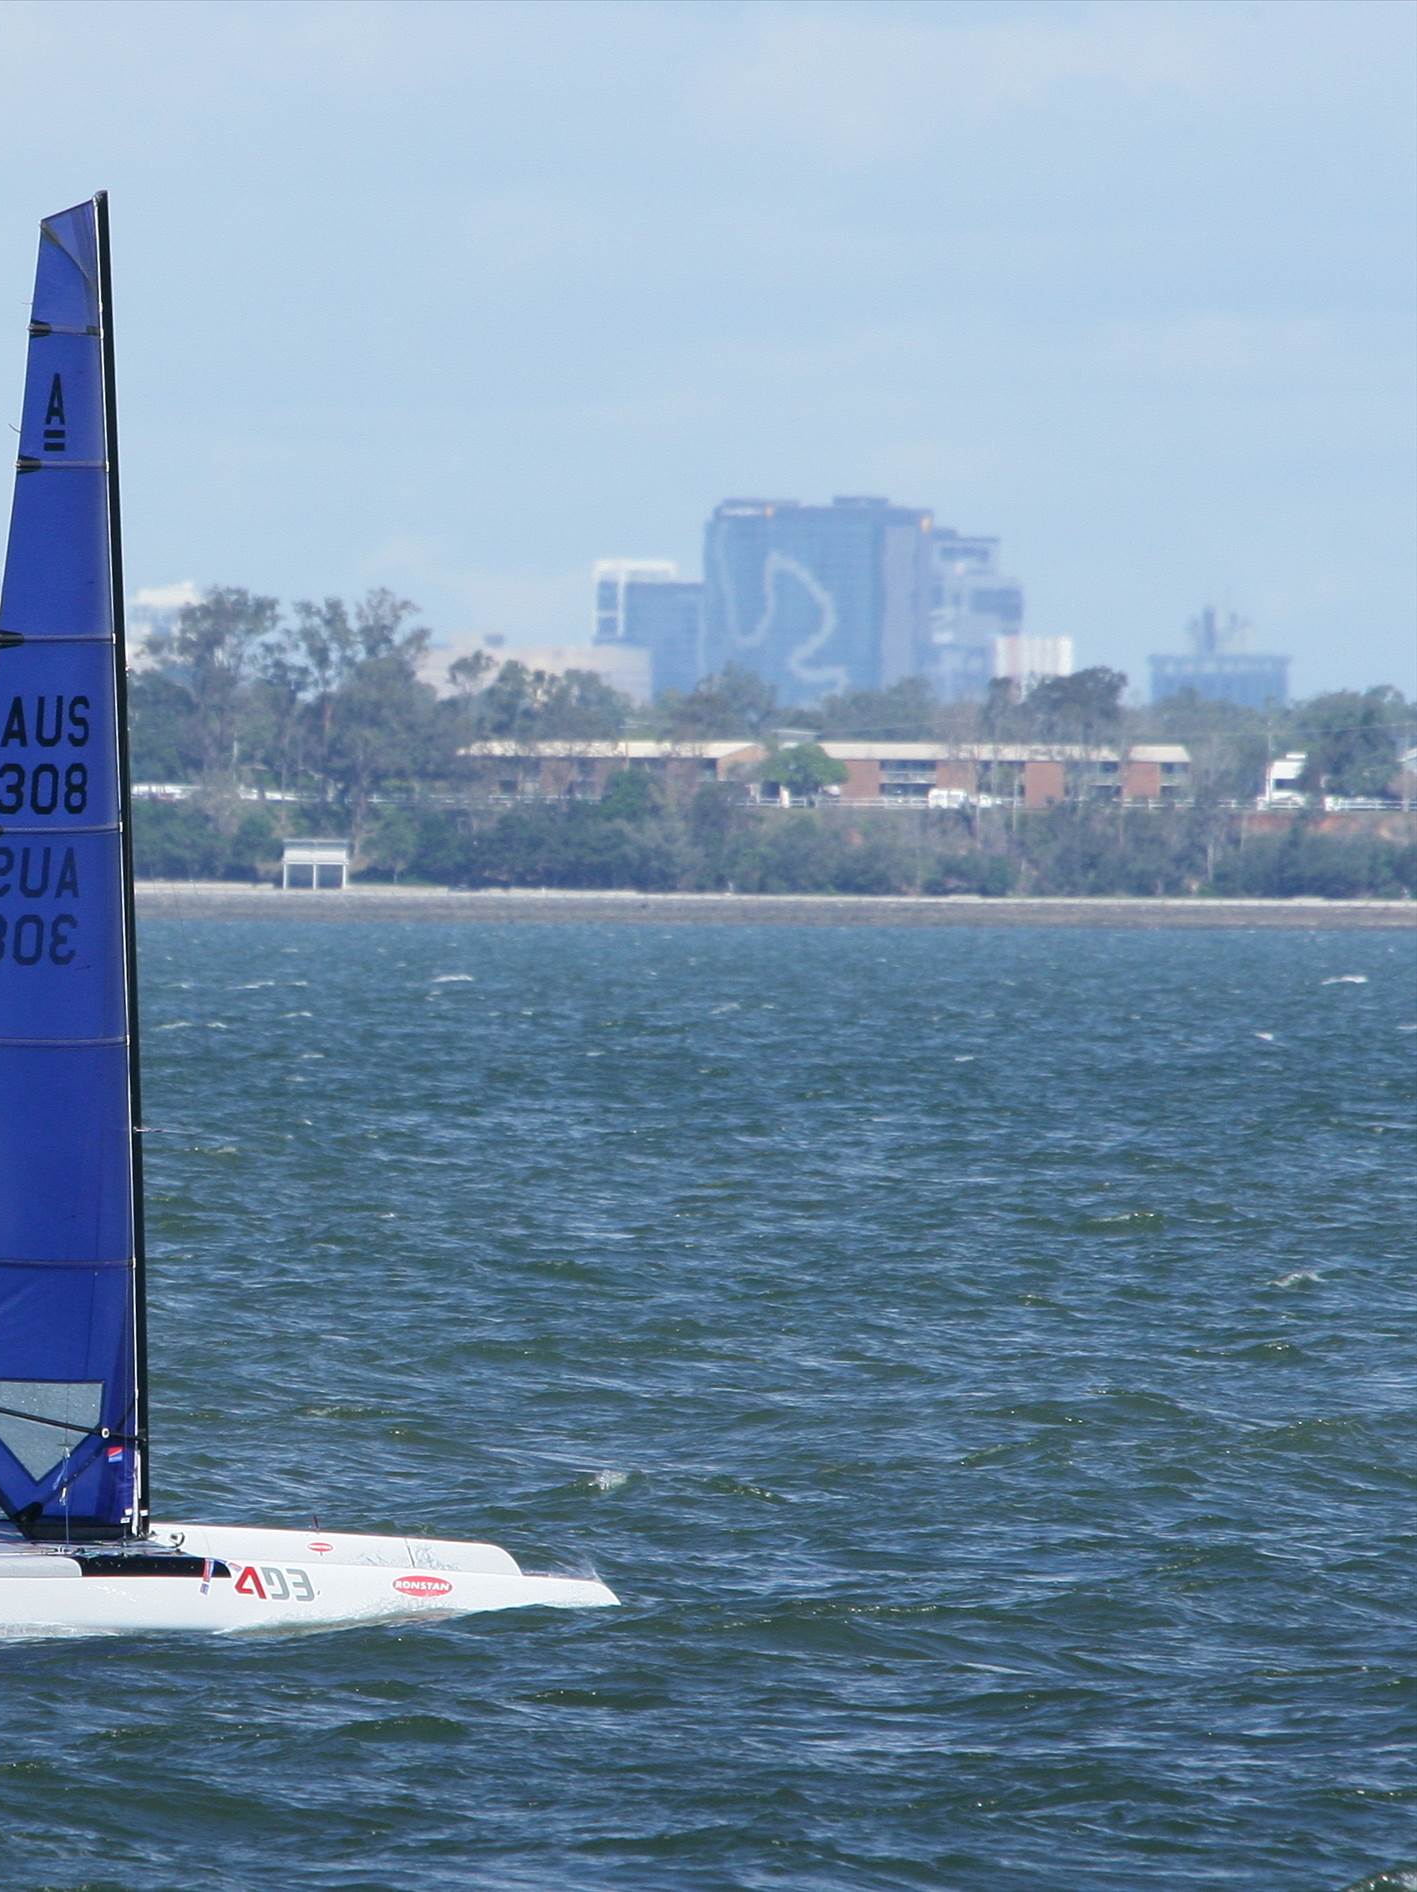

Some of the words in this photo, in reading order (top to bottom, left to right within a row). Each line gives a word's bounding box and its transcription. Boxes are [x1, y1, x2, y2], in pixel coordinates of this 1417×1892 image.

[45, 372, 65, 425] A
[0, 696, 89, 747] AUS
[395, 1580, 450, 1591] RONSTAN
